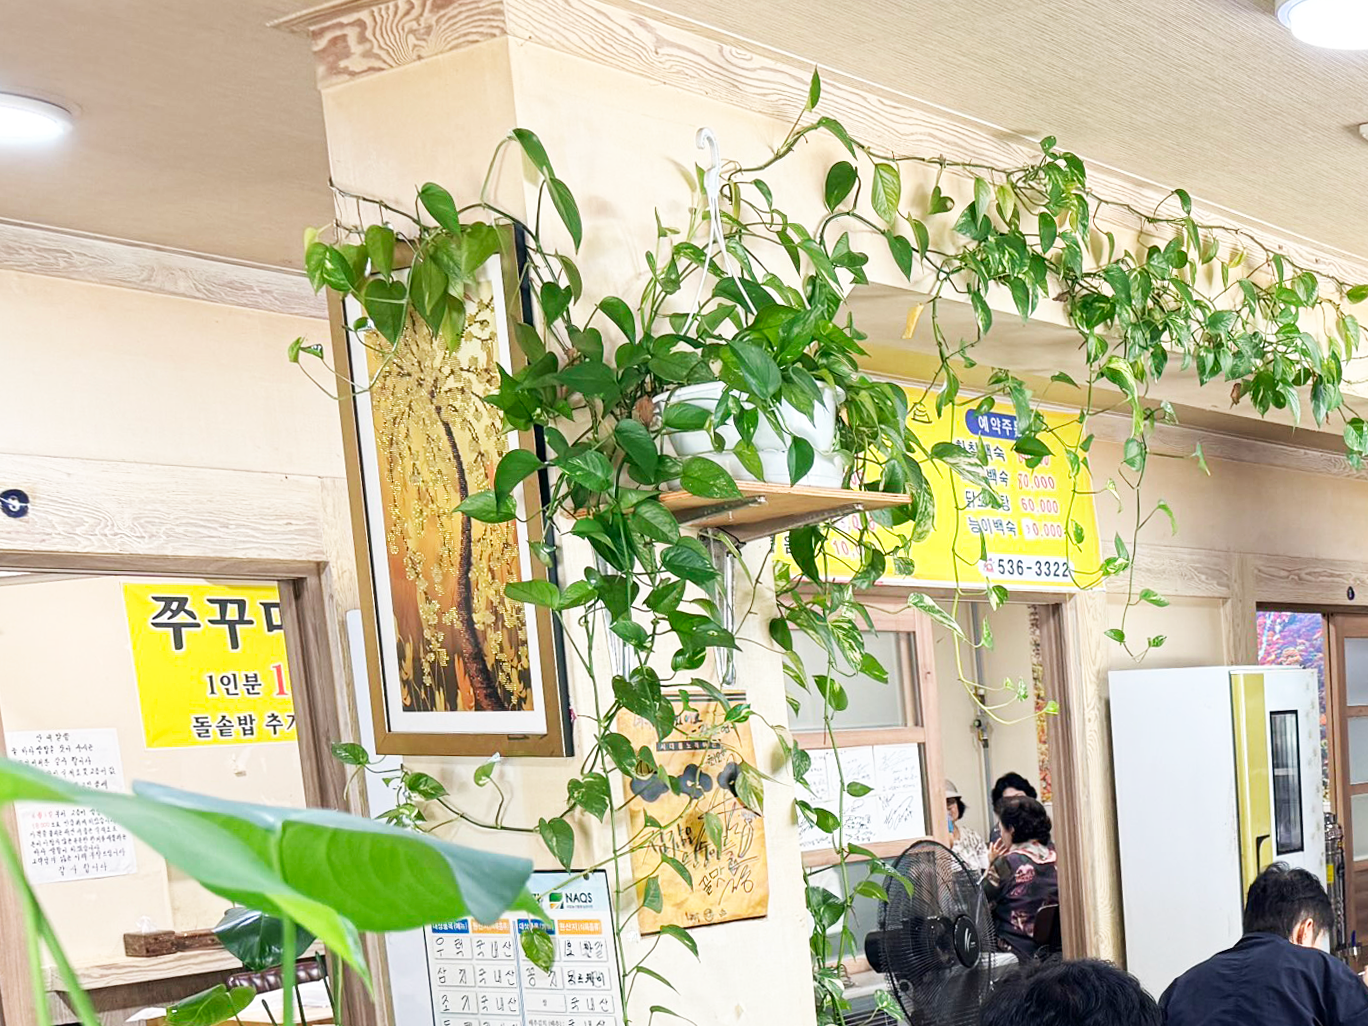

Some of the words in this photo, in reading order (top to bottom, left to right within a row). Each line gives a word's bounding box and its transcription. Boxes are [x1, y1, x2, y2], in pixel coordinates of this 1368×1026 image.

[998, 559, 1069, 577] 536-3322
[207, 673, 262, 696] 1인분
[193, 714, 256, 738] 돌솥밥
[565, 892, 593, 903] NAQS
